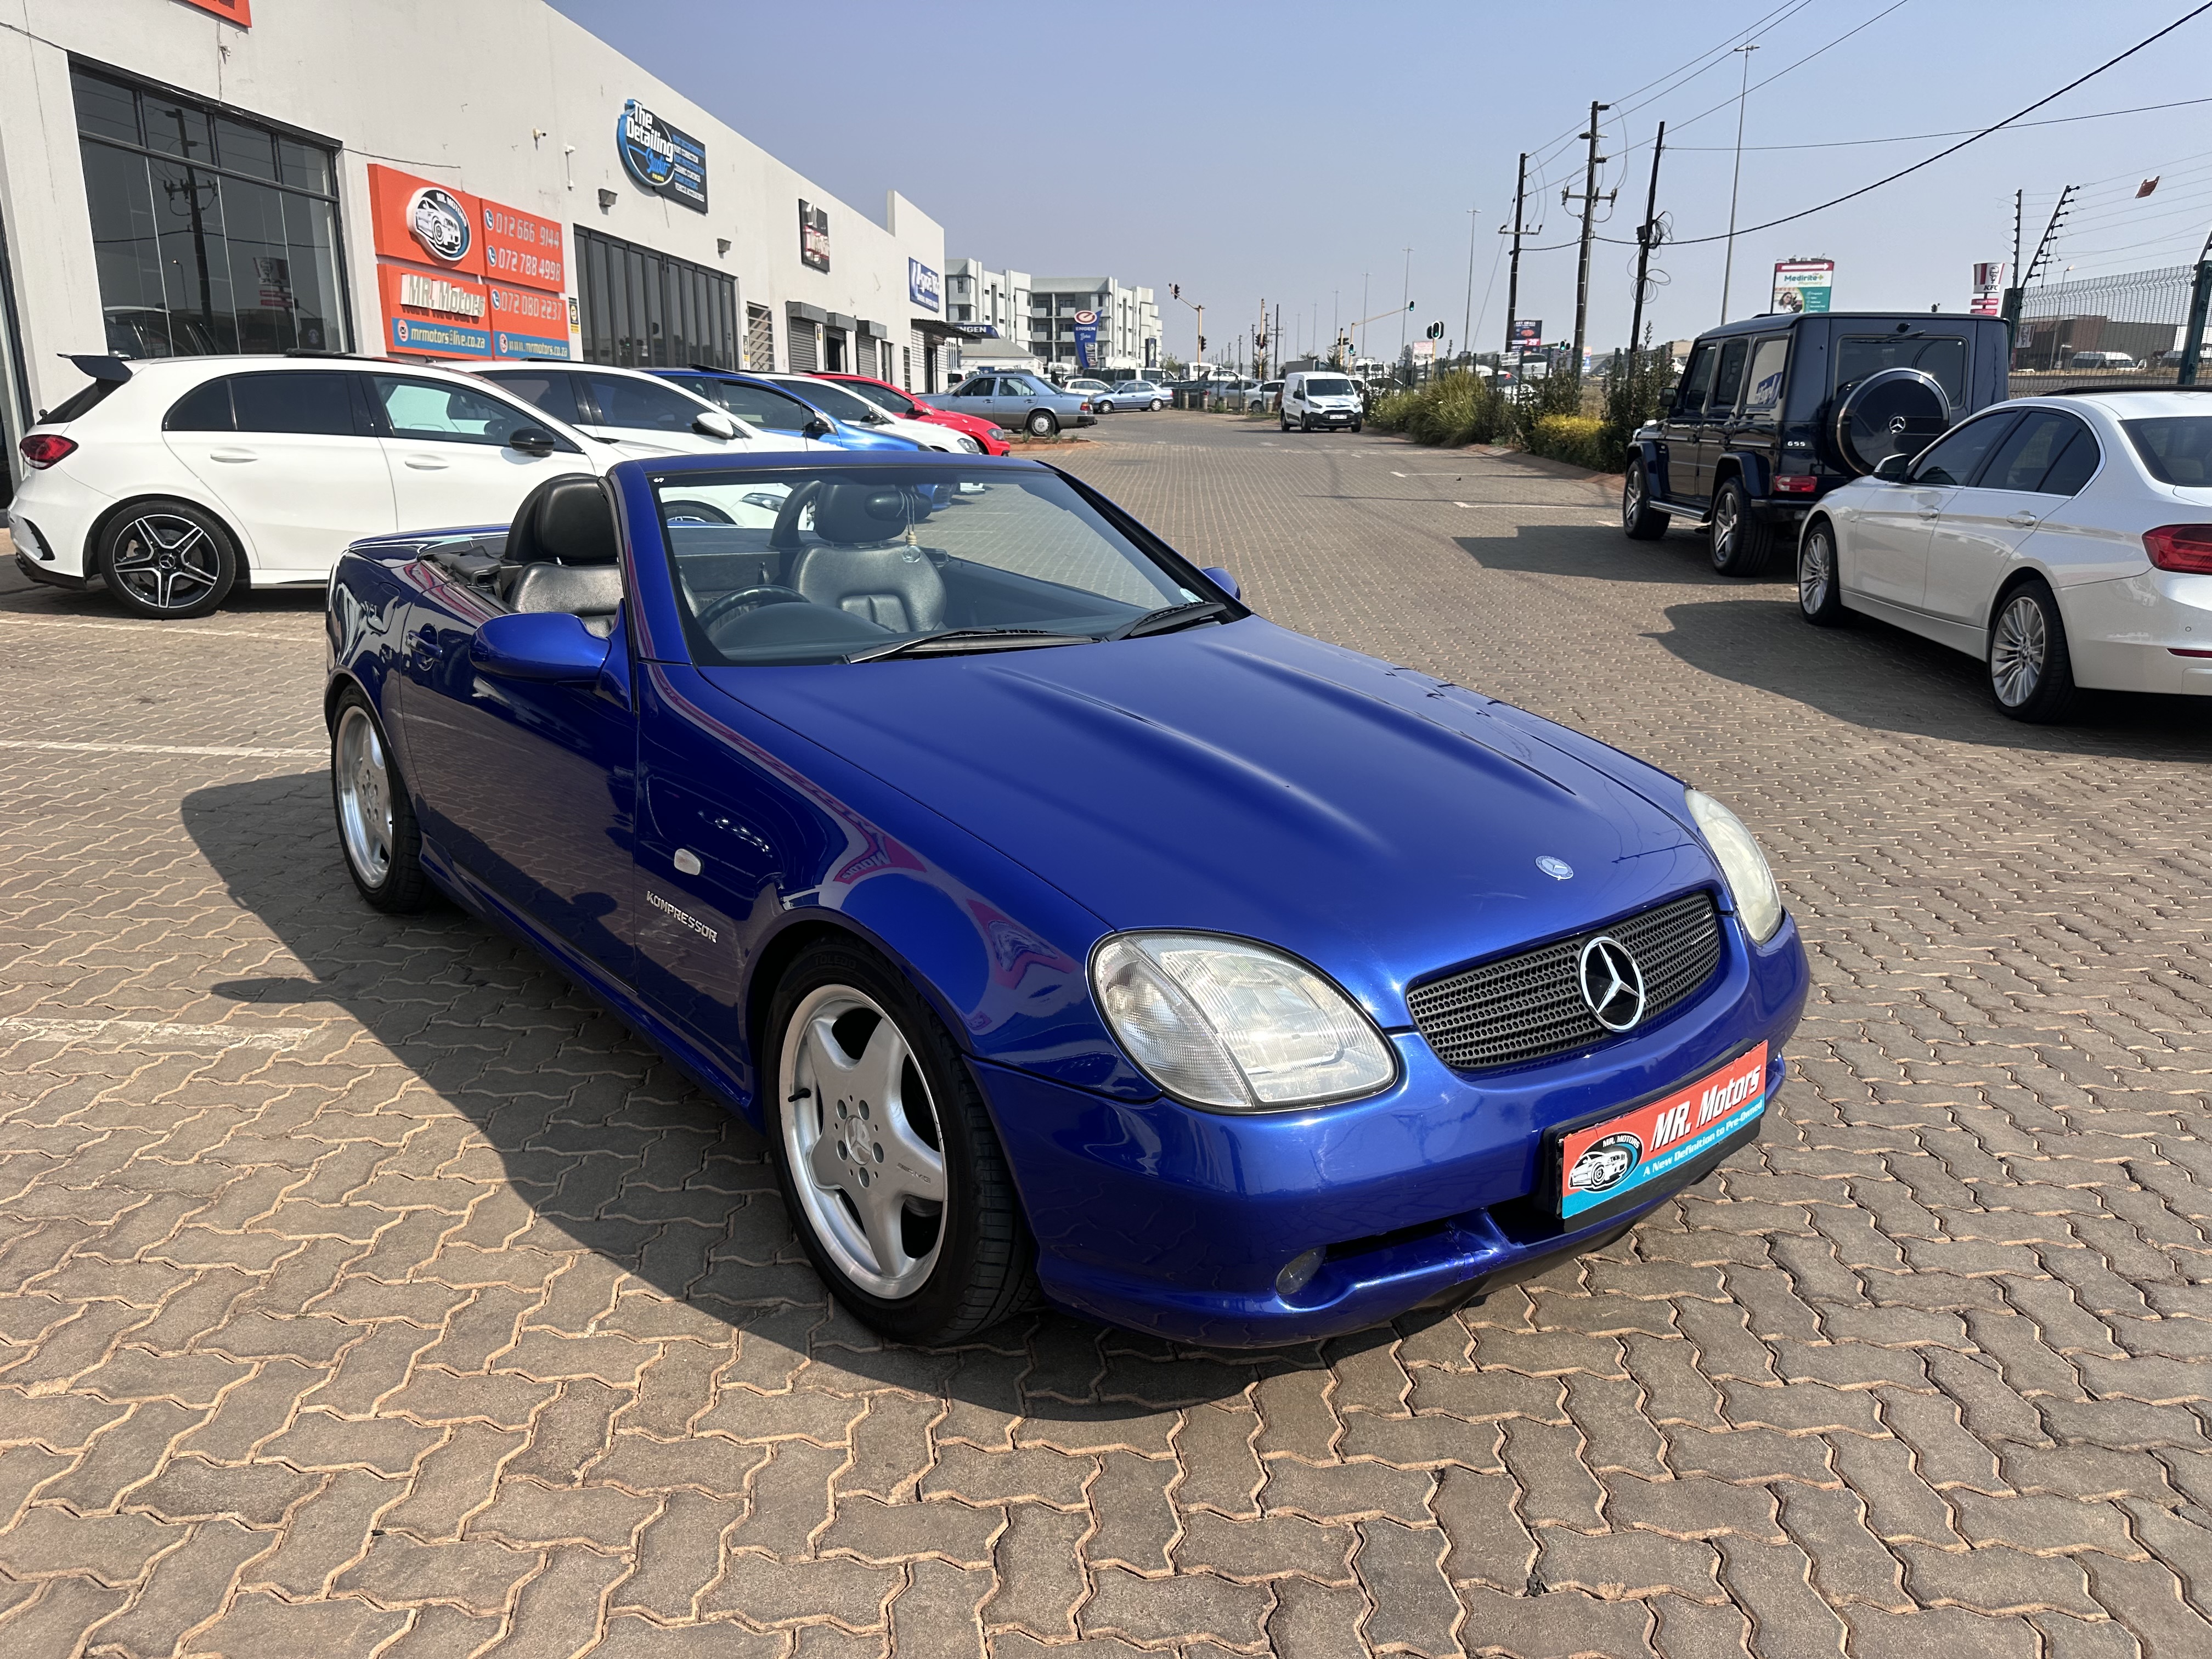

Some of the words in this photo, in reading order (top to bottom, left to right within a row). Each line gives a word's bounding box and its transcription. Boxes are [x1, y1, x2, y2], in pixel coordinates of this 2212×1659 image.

[633, 100, 653, 130] The
[627, 115, 674, 162] Detailing
[496, 212, 516, 237] 012
[517, 219, 535, 242] 666
[539, 225, 560, 249] 9144
[499, 247, 518, 272] 072
[519, 253, 537, 276] 788
[539, 258, 561, 281] 4998
[404, 274, 435, 308] MR.
[436, 280, 486, 317] Motors
[501, 291, 520, 314] 072
[522, 295, 539, 317] 080
[541, 299, 563, 321] 2237
[646, 890, 718, 943] KOMPRESSOR
[813, 953, 856, 969] TOLEDO
[1649, 1101, 1692, 1152] MR.
[1696, 1065, 1762, 1129] Motors
[1602, 1137, 1615, 1148] MR.
[1616, 1135, 1640, 1149] MOTORS
[1643, 1166, 1654, 1177] A
[1652, 1156, 1673, 1172] New
[1674, 1132, 1715, 1161] Definition
[1716, 1126, 1724, 1137] to
[1726, 1099, 1763, 1132] Pre-Owned
